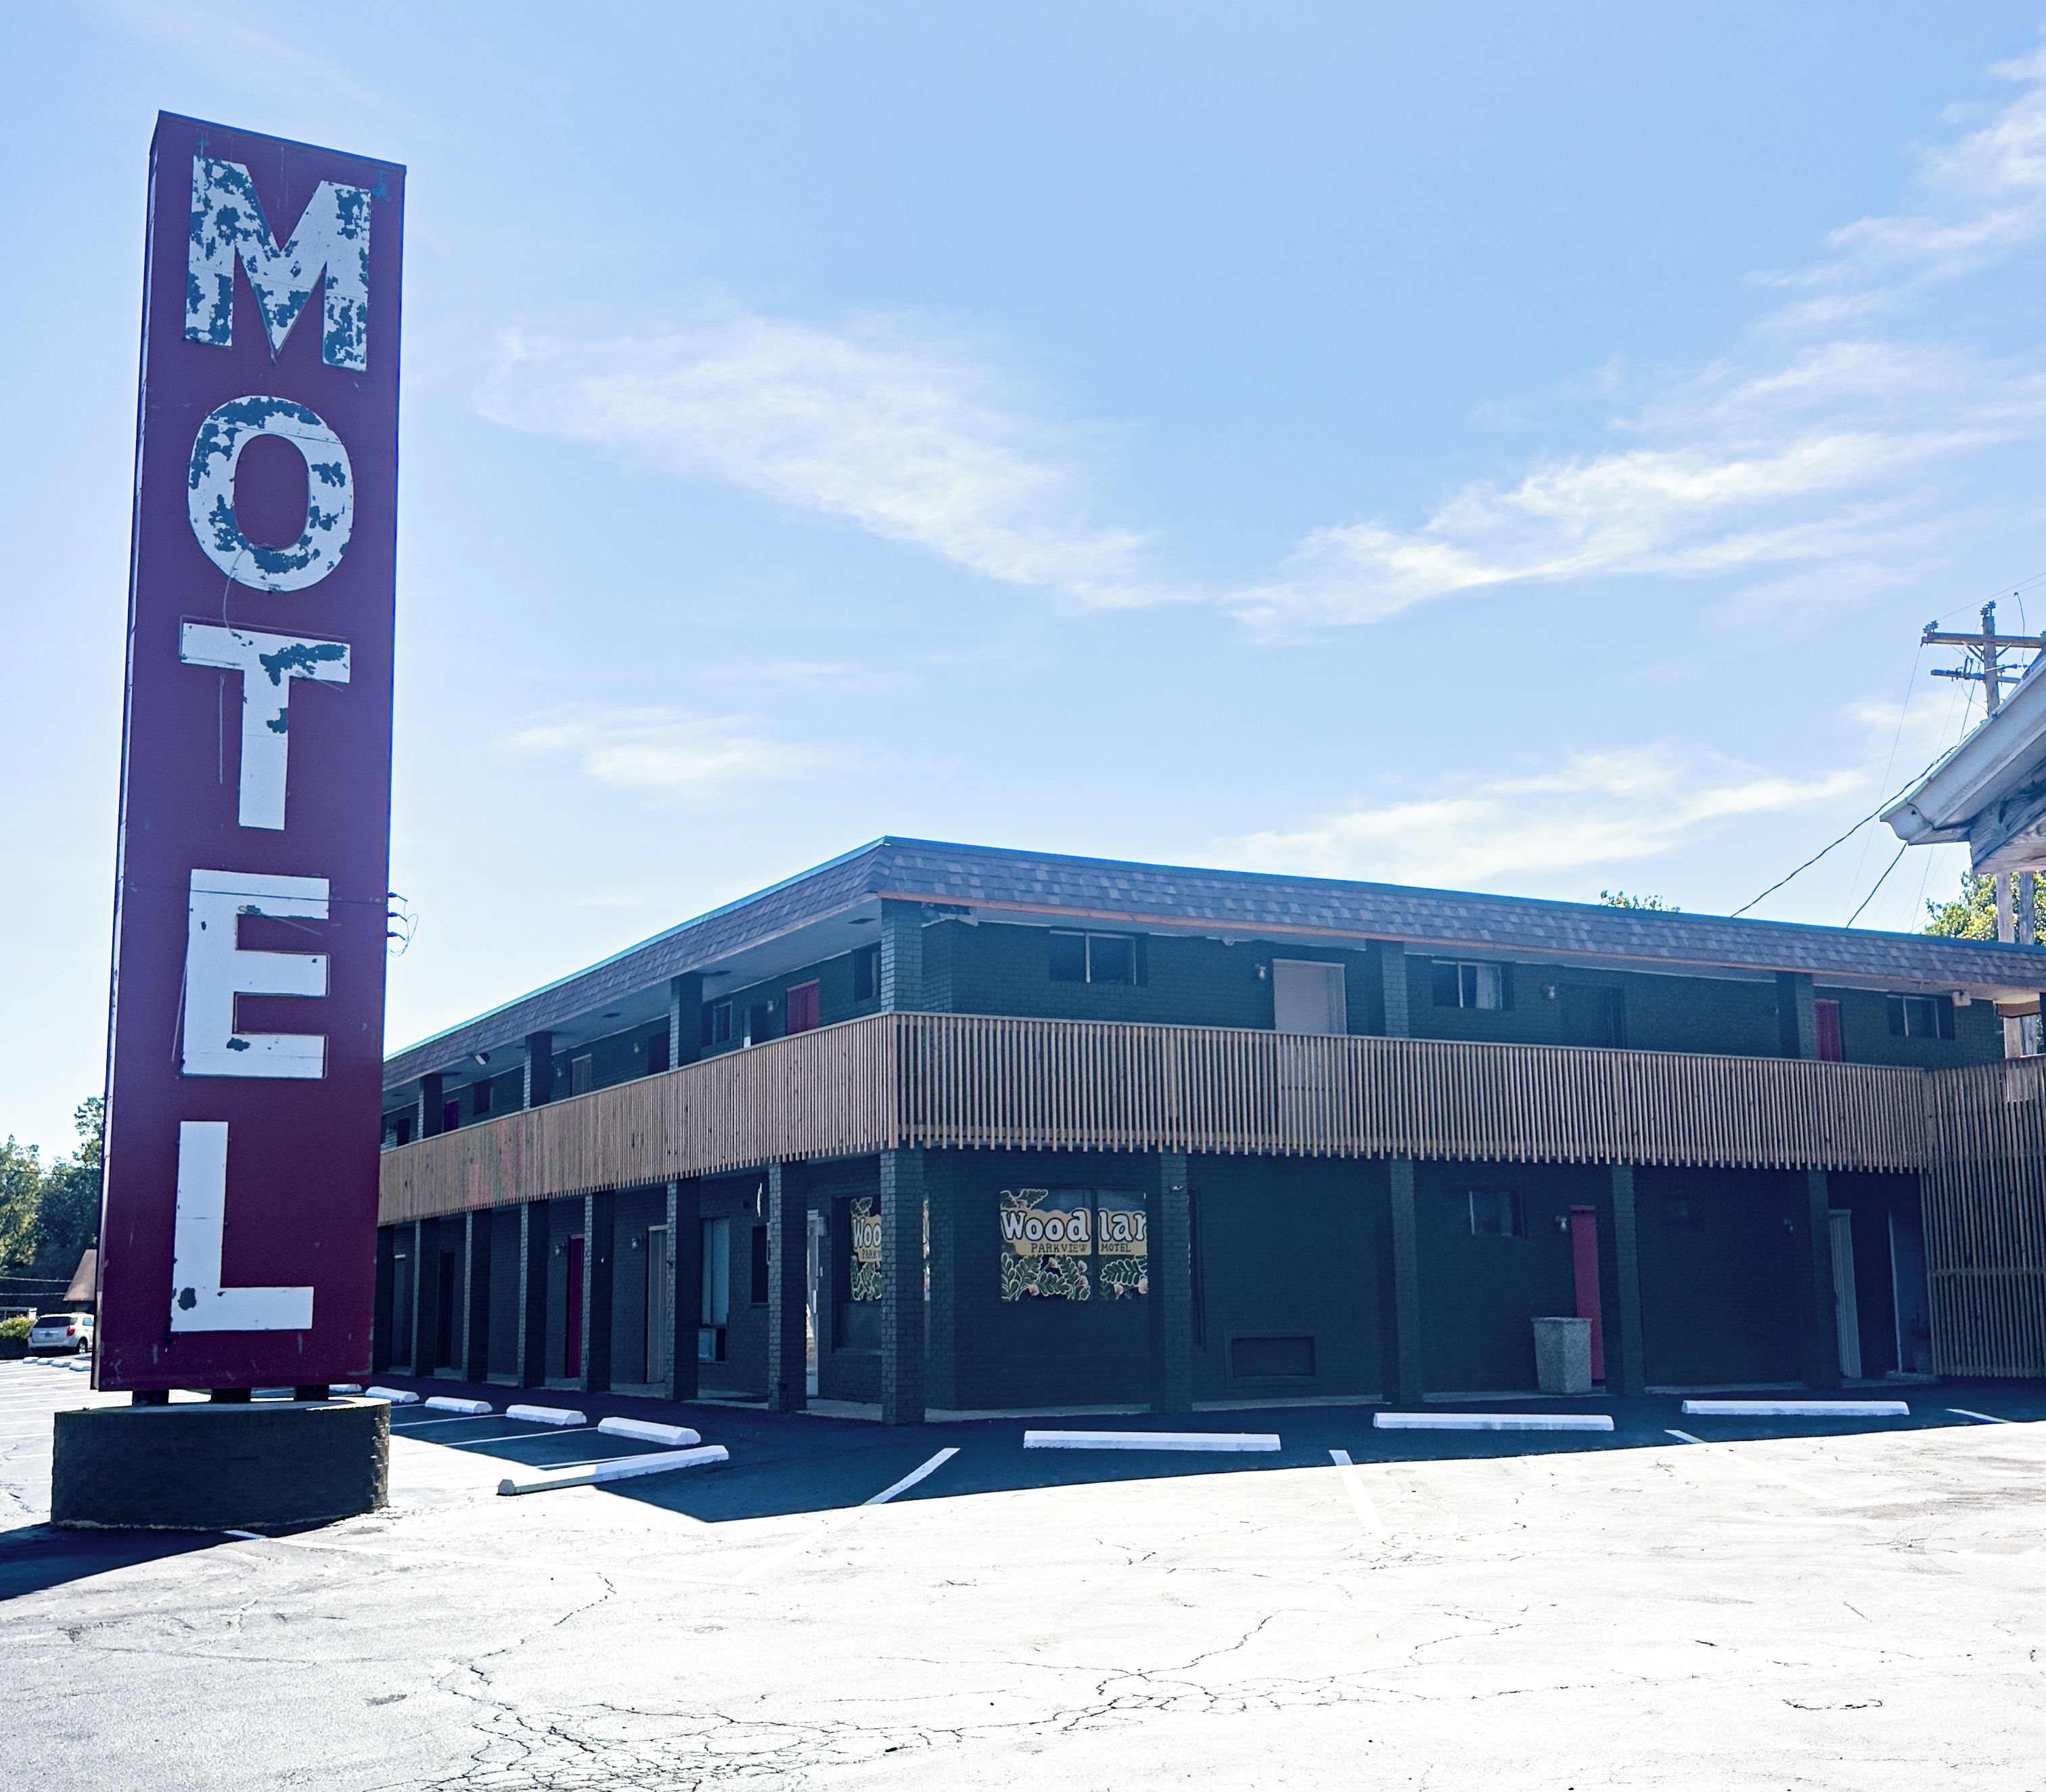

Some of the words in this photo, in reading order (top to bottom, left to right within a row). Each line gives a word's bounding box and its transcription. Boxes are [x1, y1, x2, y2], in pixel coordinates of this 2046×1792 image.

[170, 154, 371, 1332] MOTEL
[1030, 1243, 1087, 1254] PARKVIEW
[1100, 1243, 1131, 1253] MOTEL
